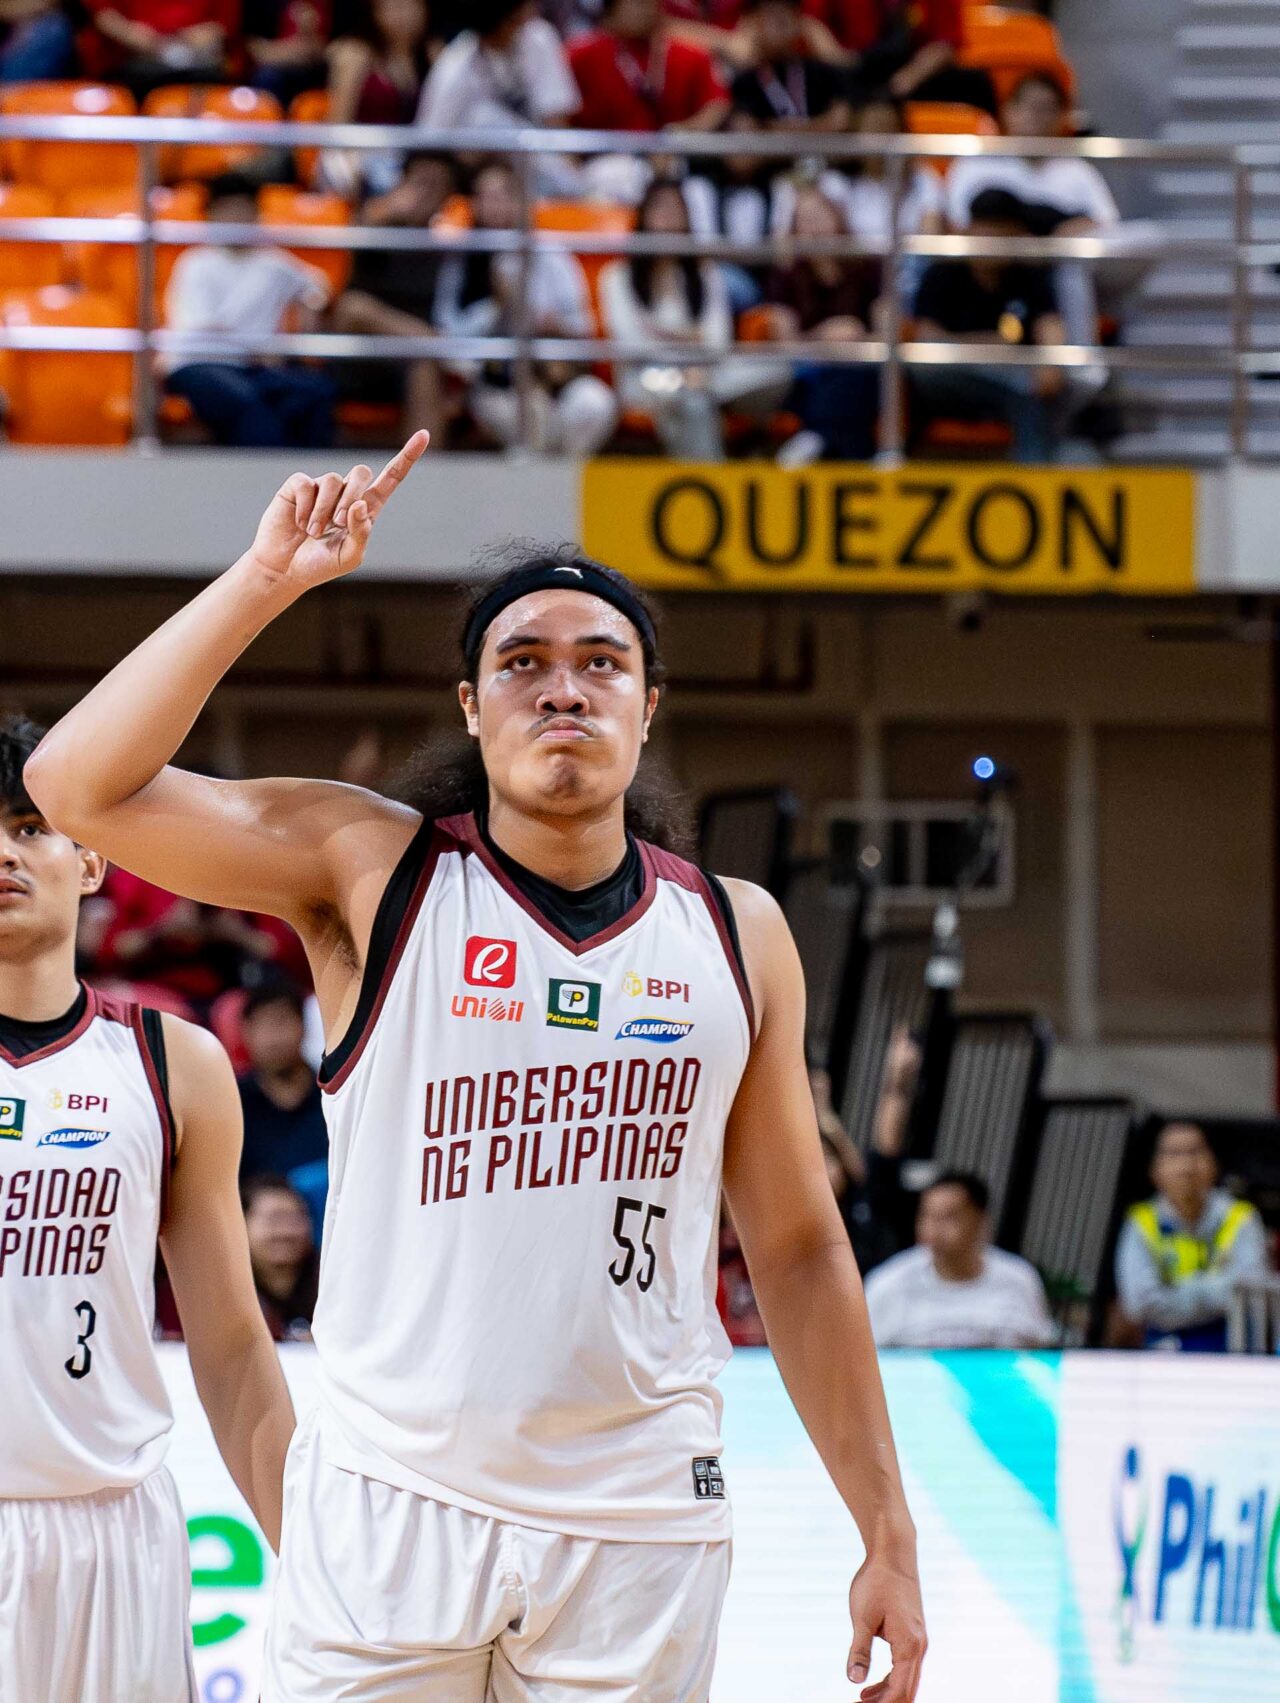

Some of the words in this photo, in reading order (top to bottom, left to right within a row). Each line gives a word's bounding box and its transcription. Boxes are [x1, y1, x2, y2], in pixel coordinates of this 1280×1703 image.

[650, 474, 1128, 579] QUEZON
[621, 1022, 690, 1036] CHAMPION
[646, 977, 689, 1003] BPI
[40, 1131, 108, 1144] CHAMPION
[67, 1094, 108, 1113] BPI
[423, 1057, 702, 1140] UNIBERSIDAD
[420, 1139, 472, 1206] NG
[485, 1121, 689, 1193] PILIPINAS
[608, 1196, 667, 1293] 55
[64, 1300, 96, 1379] 3
[1153, 1473, 1280, 1636] Phil
